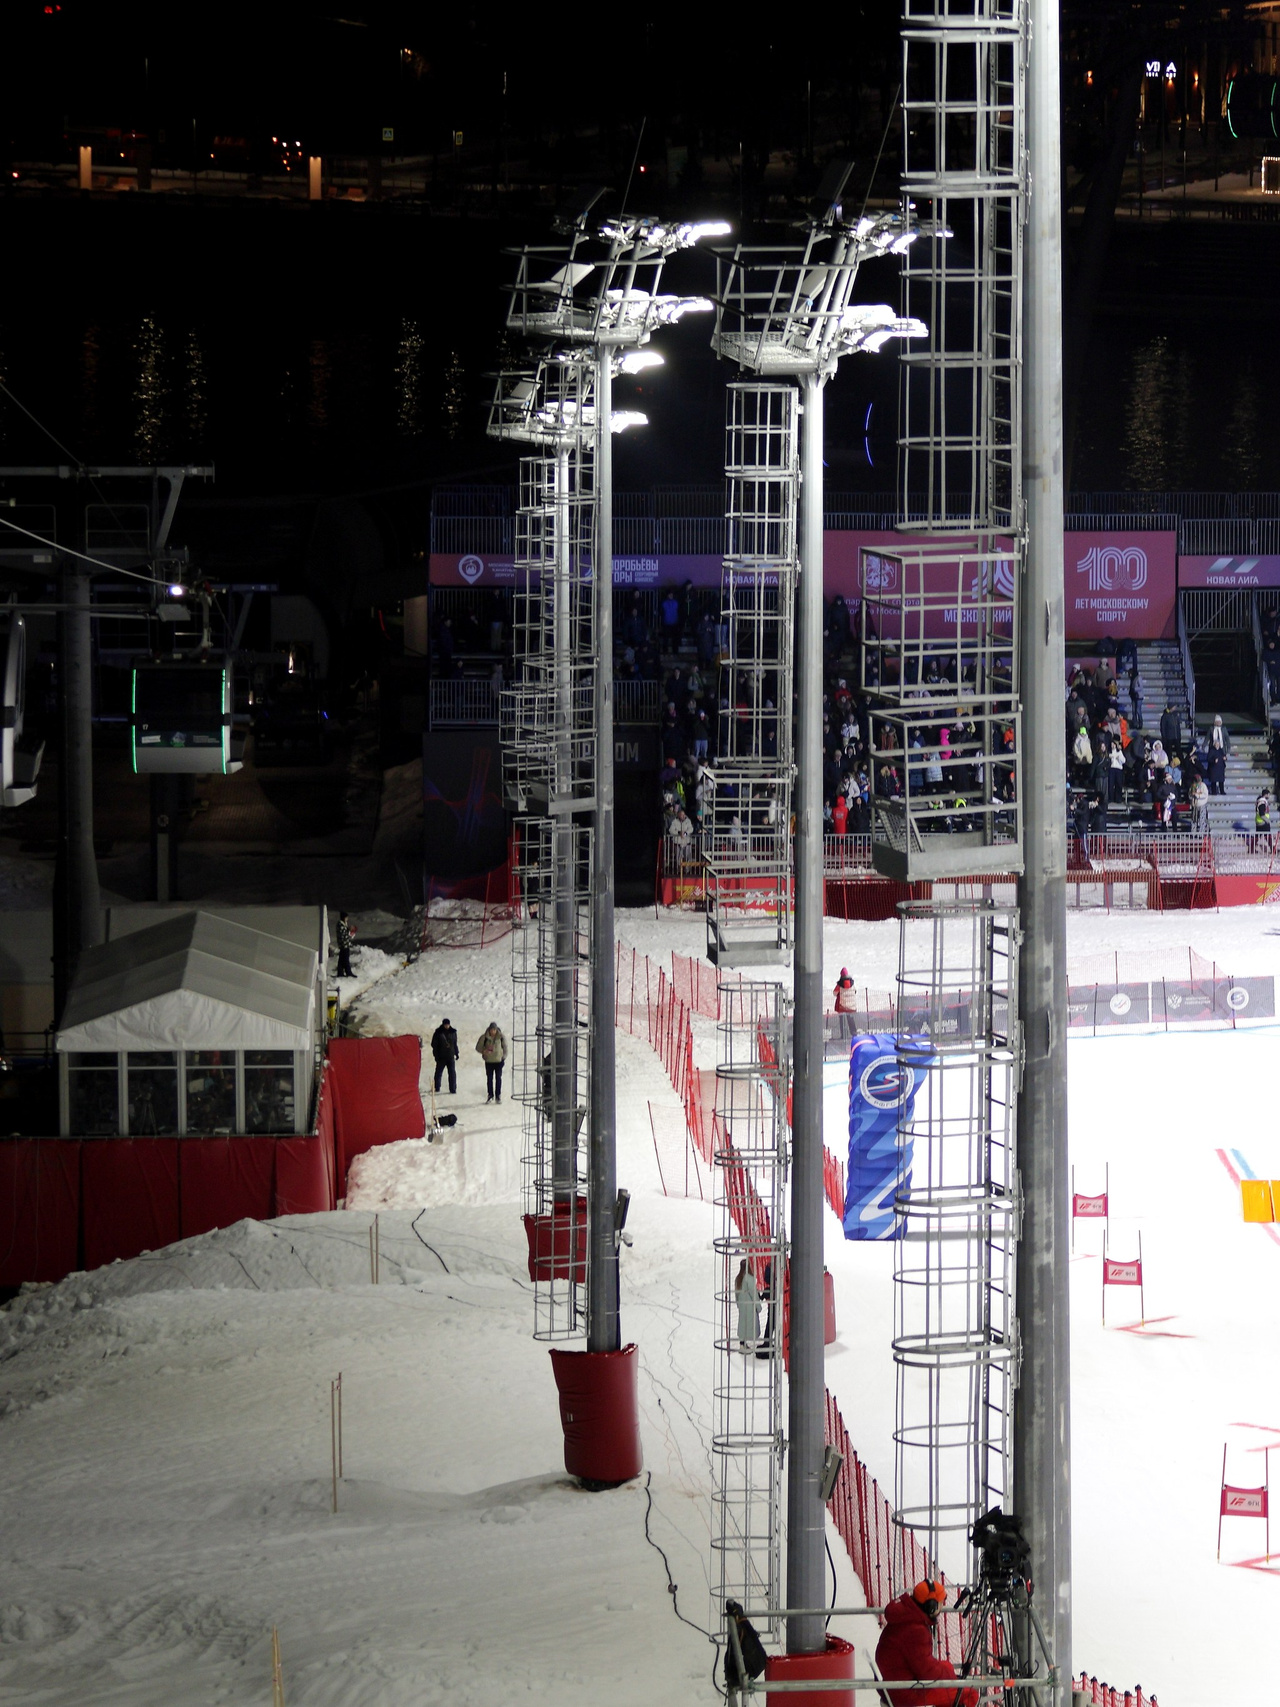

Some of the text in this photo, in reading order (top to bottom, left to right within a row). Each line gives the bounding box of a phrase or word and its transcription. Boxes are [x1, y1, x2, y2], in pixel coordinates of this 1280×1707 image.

[611, 558, 659, 571] ОРОБЬЁВЫ
[1077, 546, 1147, 590] 100
[612, 571, 633, 583] ОРЫ
[725, 575, 755, 585] НОВАЯ
[1206, 576, 1259, 585] НОВАЯ ЛИГА
[891, 598, 921, 606] спрта
[1075, 598, 1149, 609] ЛЕТ МОСКОВСКОМУ
[944, 606, 1012, 623] МОСКОВКИЙ
[1096, 610, 1127, 622] СПОРТУ
